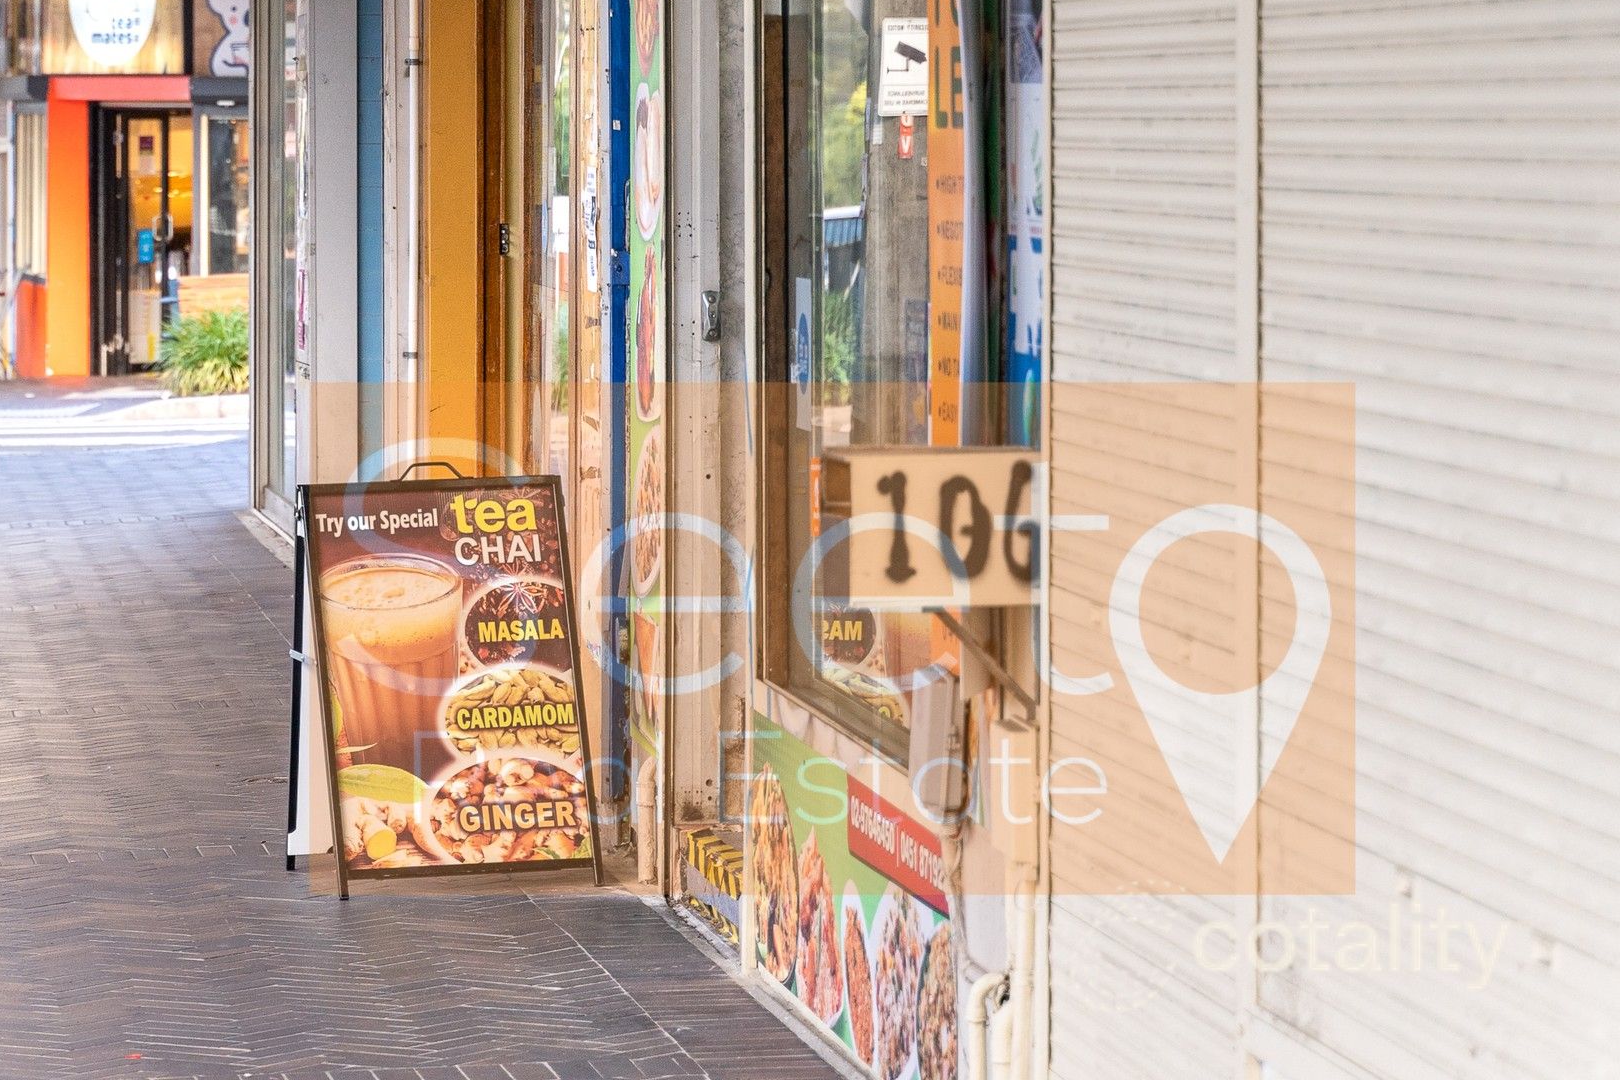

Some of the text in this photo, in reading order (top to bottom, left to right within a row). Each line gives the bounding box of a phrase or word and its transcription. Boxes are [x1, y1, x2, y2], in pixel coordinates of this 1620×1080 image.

[316, 508, 438, 538] Try our Special
[450, 494, 537, 534] tea
[877, 460, 1041, 585] 106
[454, 533, 542, 567] CHAI
[478, 618, 565, 644] MASALA
[456, 703, 575, 731] CARDAMOM
[459, 800, 578, 833] GINGER
